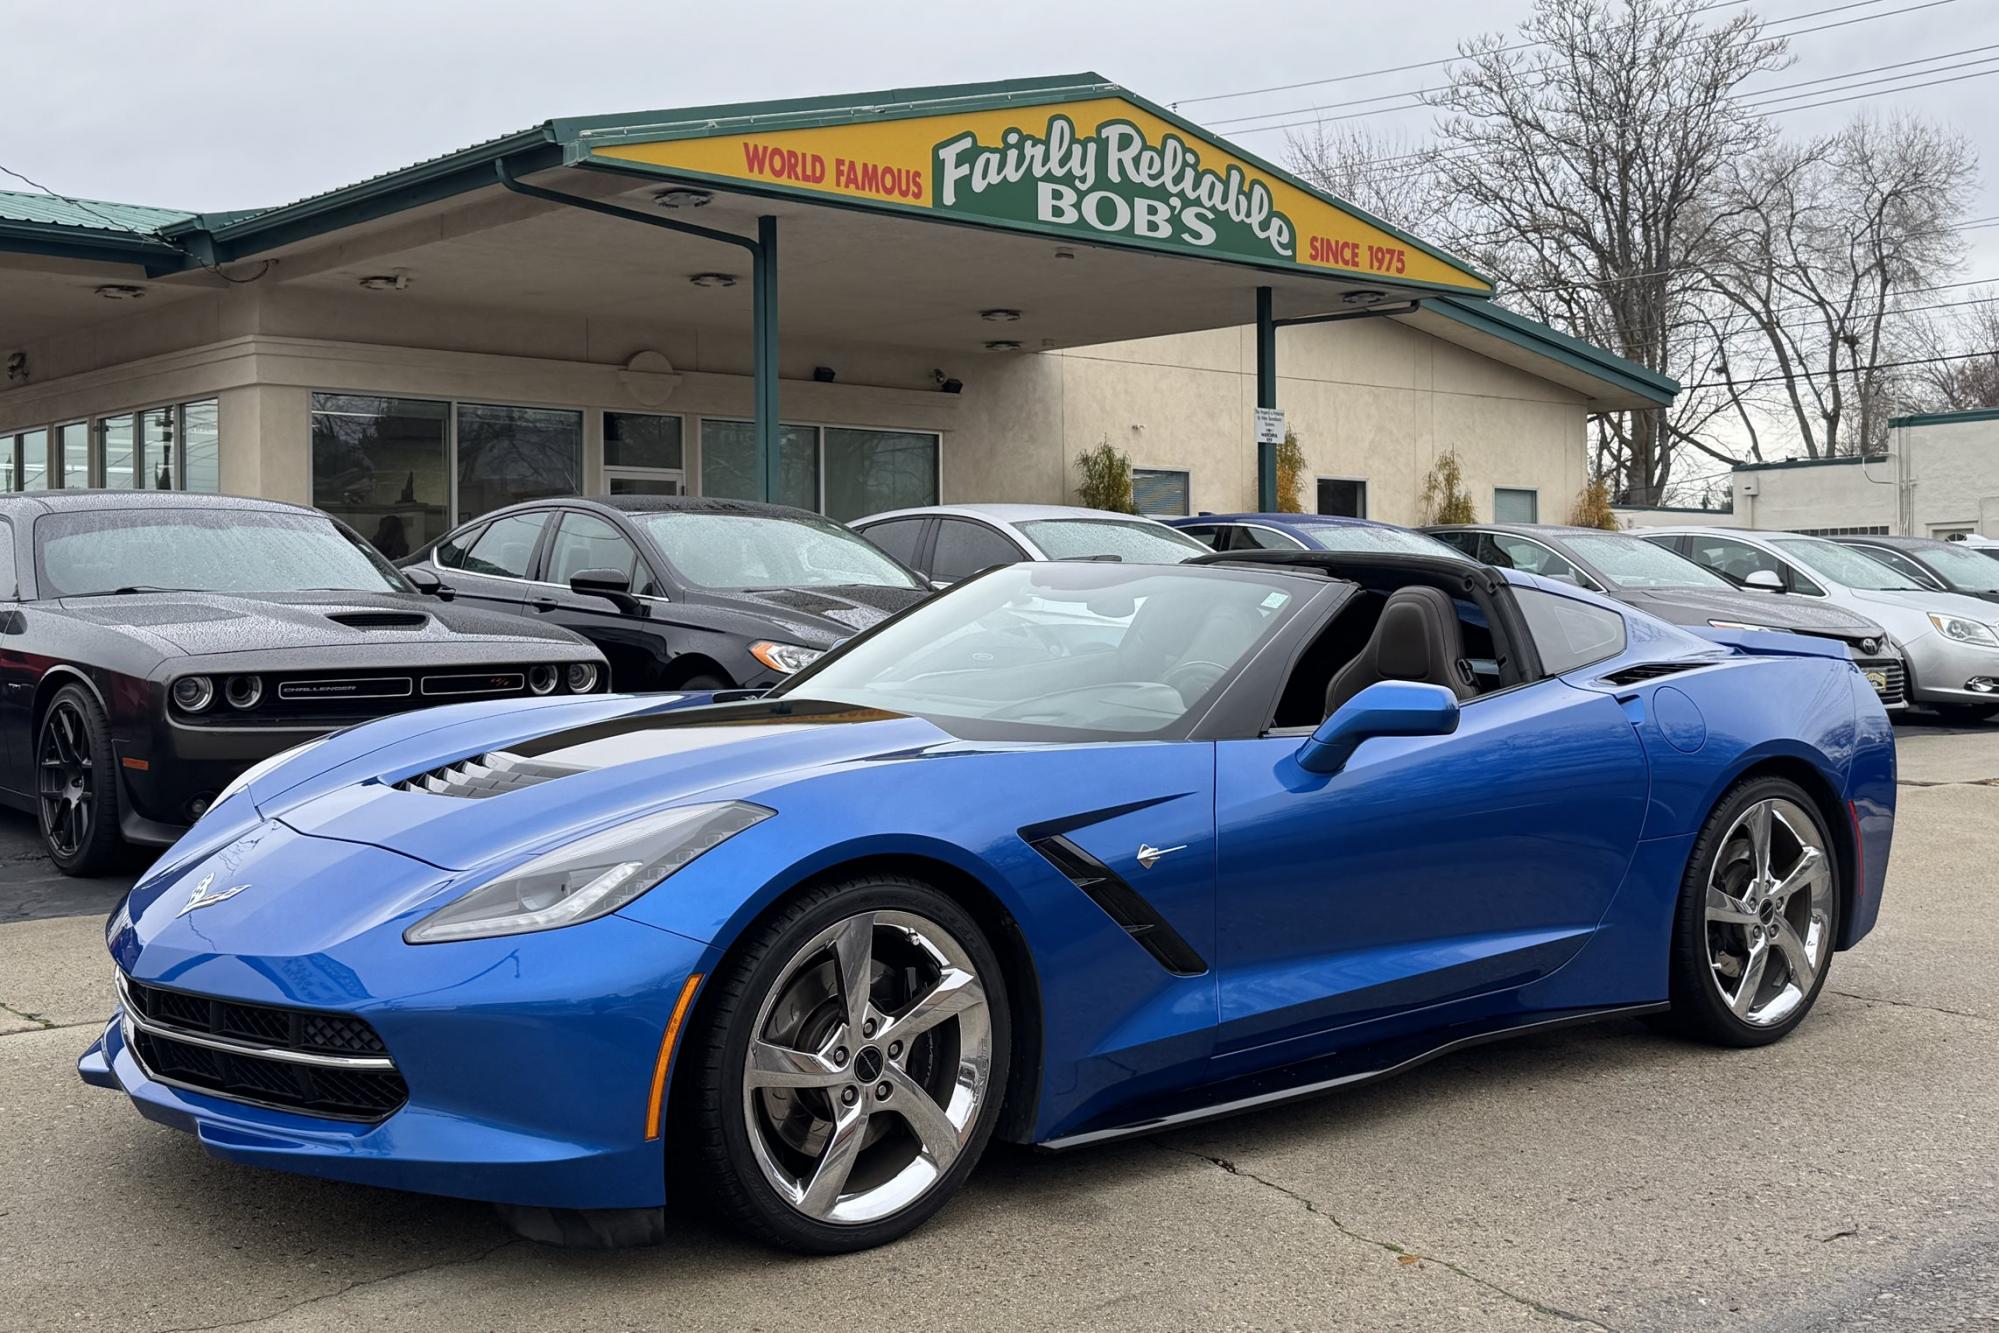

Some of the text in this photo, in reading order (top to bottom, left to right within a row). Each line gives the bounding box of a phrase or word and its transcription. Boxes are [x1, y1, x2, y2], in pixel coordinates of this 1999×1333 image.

[743, 142, 924, 200] WORLD FAMOUS
[938, 119, 1294, 256] Fairly Reliable
[1036, 181, 1218, 247] BOB'S
[1309, 236, 1406, 274] SINCE 1975
[283, 685, 357, 693] CHALLENGER
